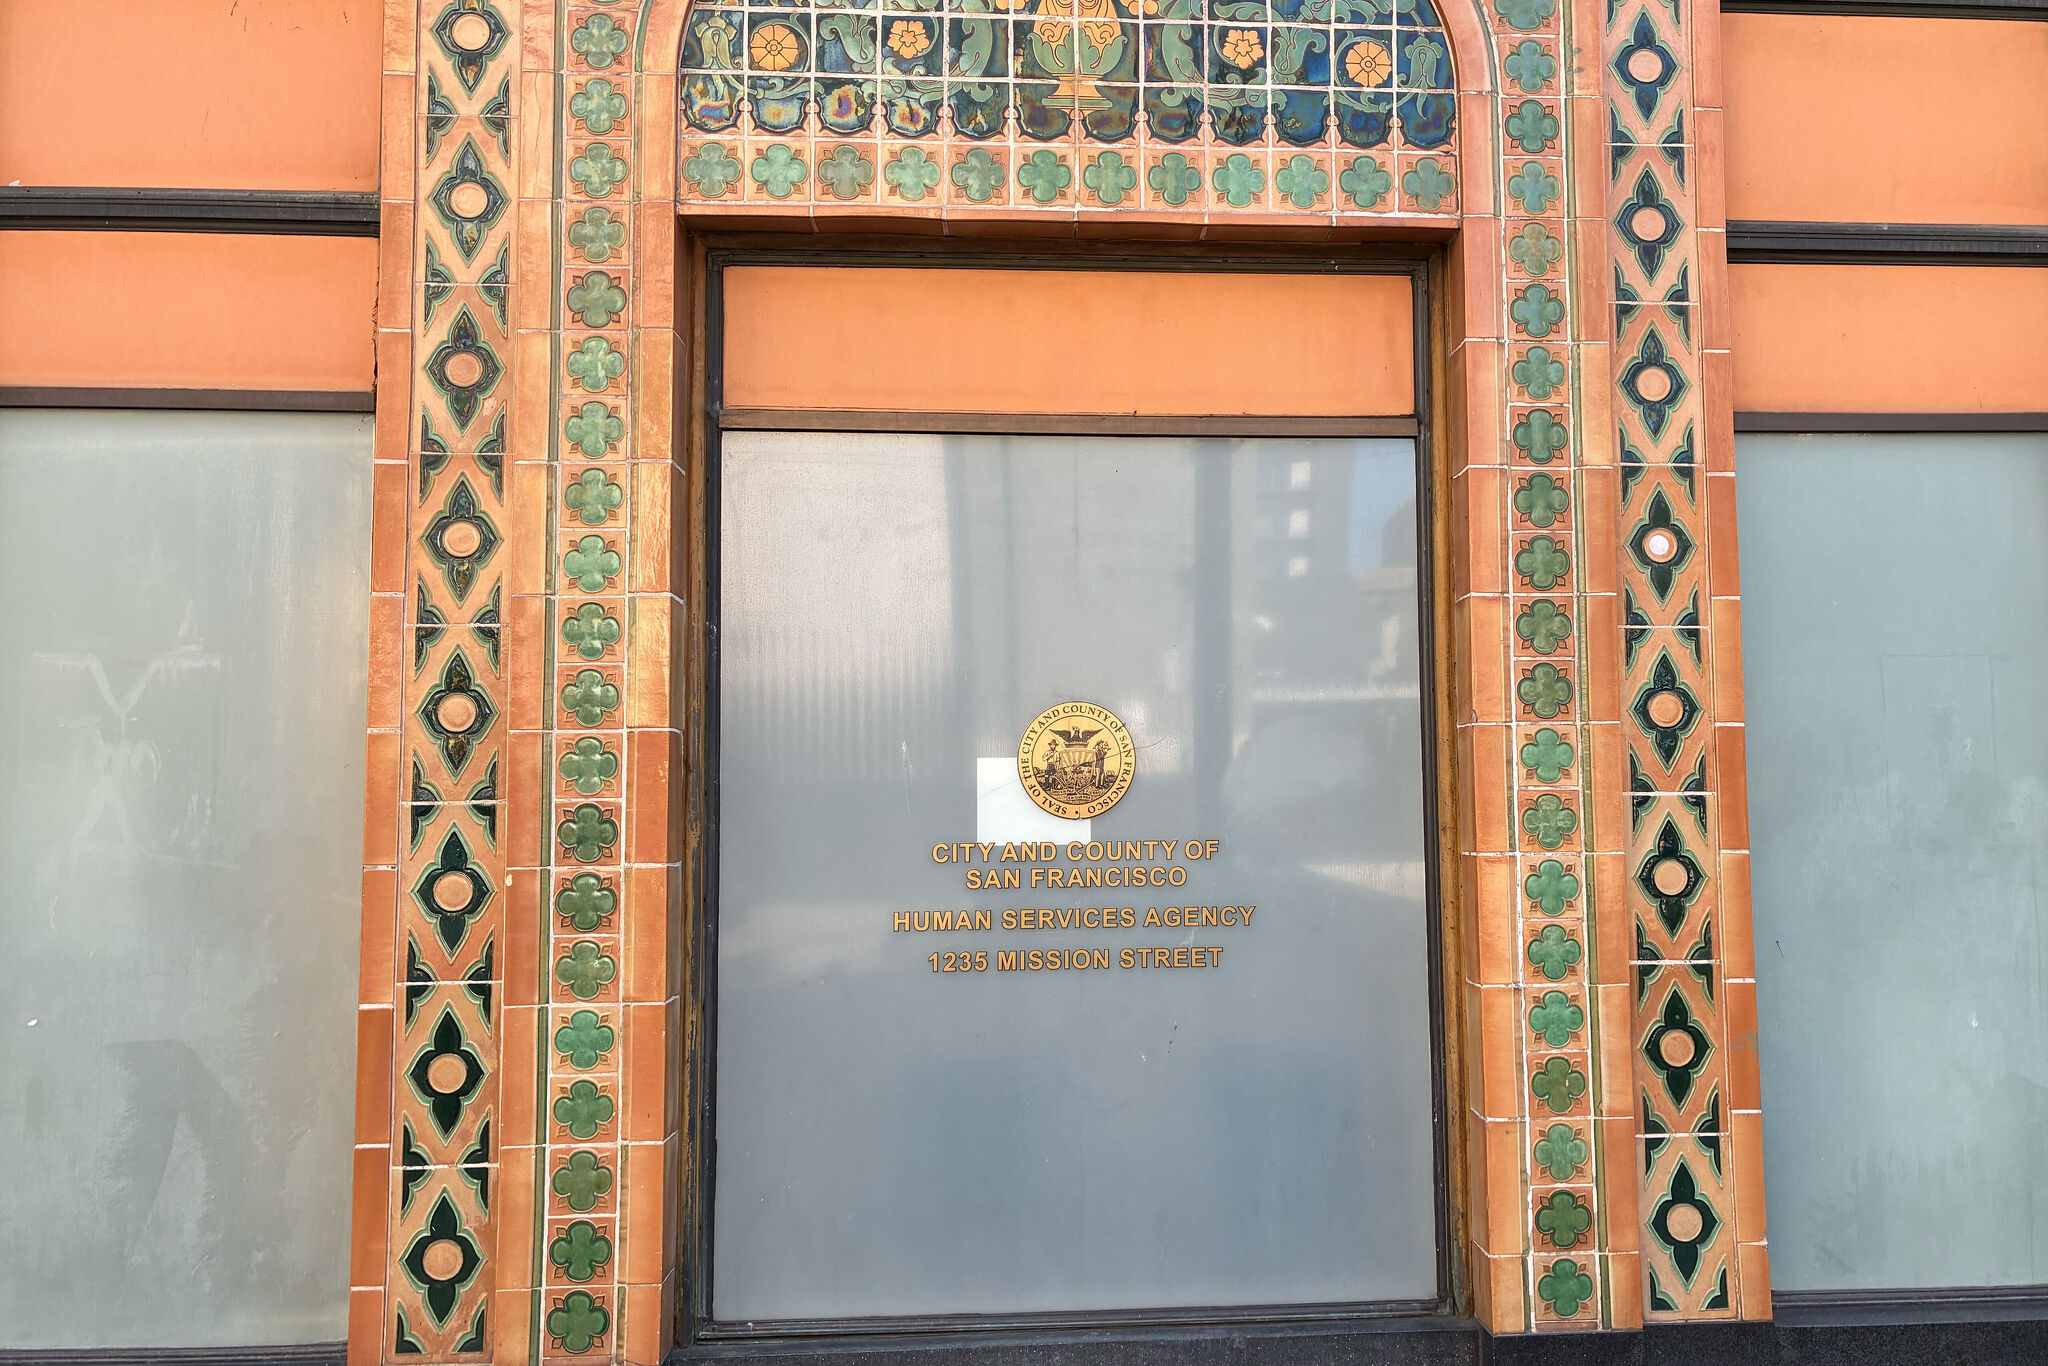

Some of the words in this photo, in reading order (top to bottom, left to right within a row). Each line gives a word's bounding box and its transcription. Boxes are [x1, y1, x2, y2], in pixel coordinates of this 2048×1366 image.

[1037, 709, 1060, 729] AND
[1062, 704, 1111, 722] COUNTY
[1109, 721, 1124, 734] OF
[1022, 727, 1038, 755] CITY
[1119, 735, 1132, 759] SAN
[1021, 757, 1032, 782] THE
[1028, 784, 1041, 797] OF
[1087, 761, 1133, 814] FRANCISCO
[1042, 796, 1068, 815] SEAL
[932, 842, 995, 863] CITY
[1000, 841, 1057, 862] AND
[1066, 840, 1178, 861] COUNTY
[1184, 839, 1220, 860] OF
[965, 868, 1021, 889] SAN
[1030, 866, 1187, 888] FRANCISCO
[893, 909, 992, 932] HUMAN
[1001, 907, 1136, 930] SERVICES
[1143, 905, 1256, 928] AGENCY
[928, 951, 989, 973] 1235
[997, 948, 1110, 971] MISSION
[1119, 946, 1224, 969] STREET
